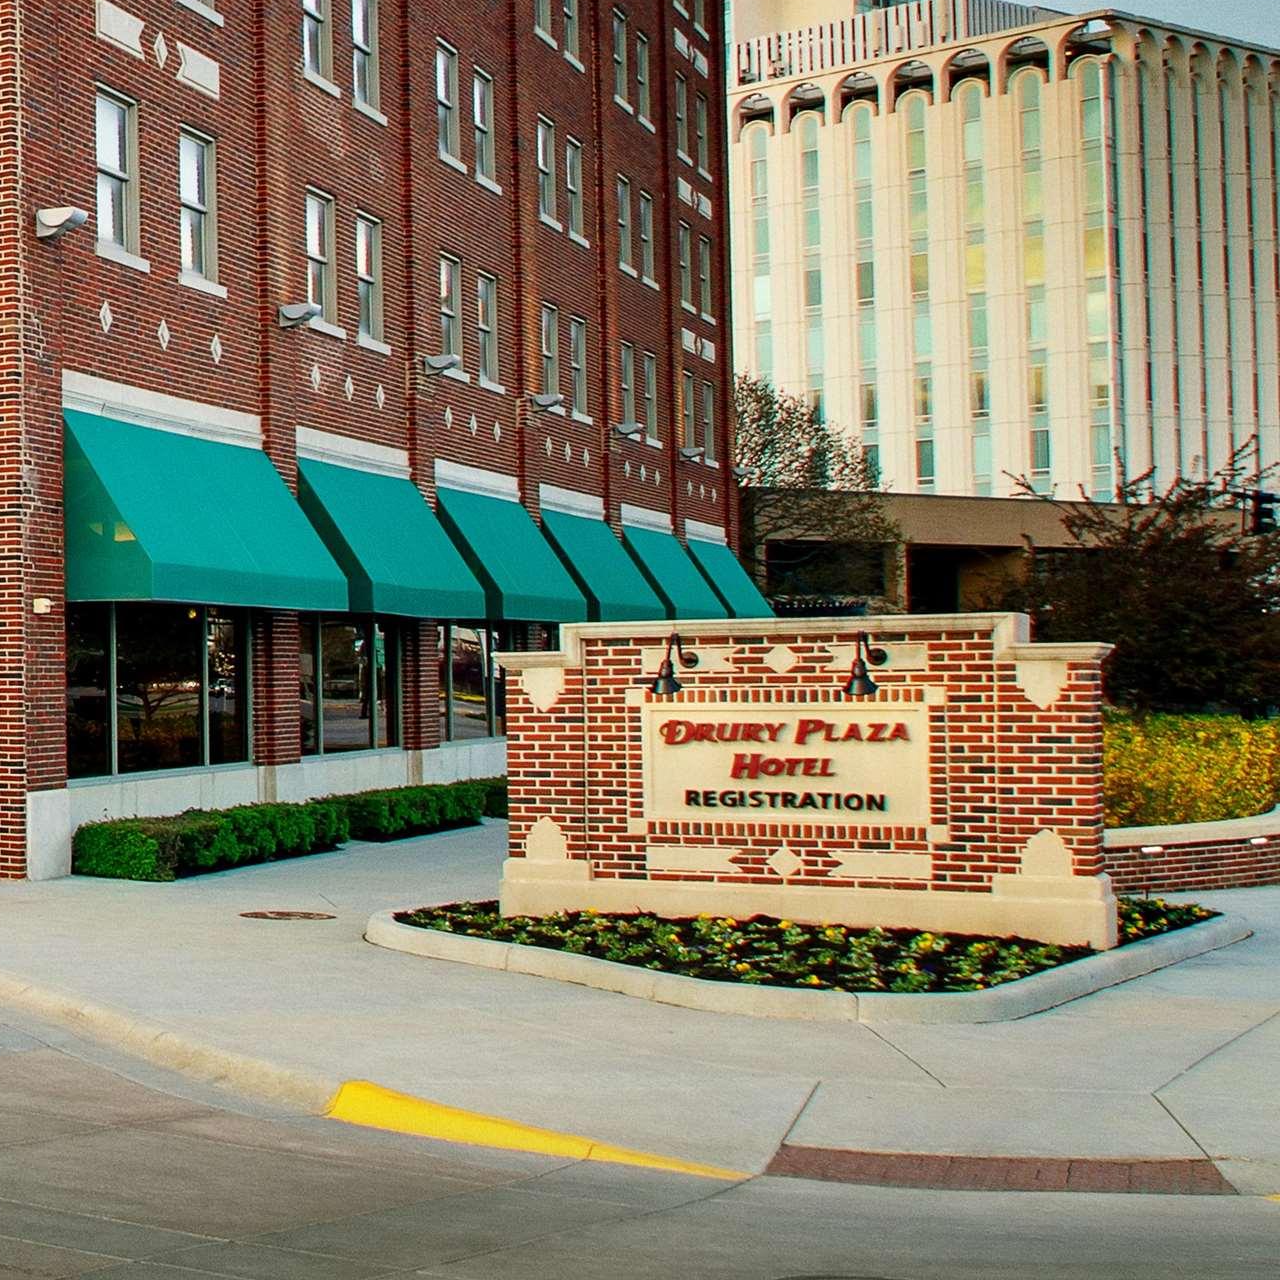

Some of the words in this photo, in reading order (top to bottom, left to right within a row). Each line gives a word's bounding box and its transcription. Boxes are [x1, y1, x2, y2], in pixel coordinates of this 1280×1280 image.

[658, 718, 787, 745] DRURY
[793, 718, 912, 746] PLAZA
[729, 752, 837, 780] HOTEL
[684, 789, 888, 812] REGISTRATION
